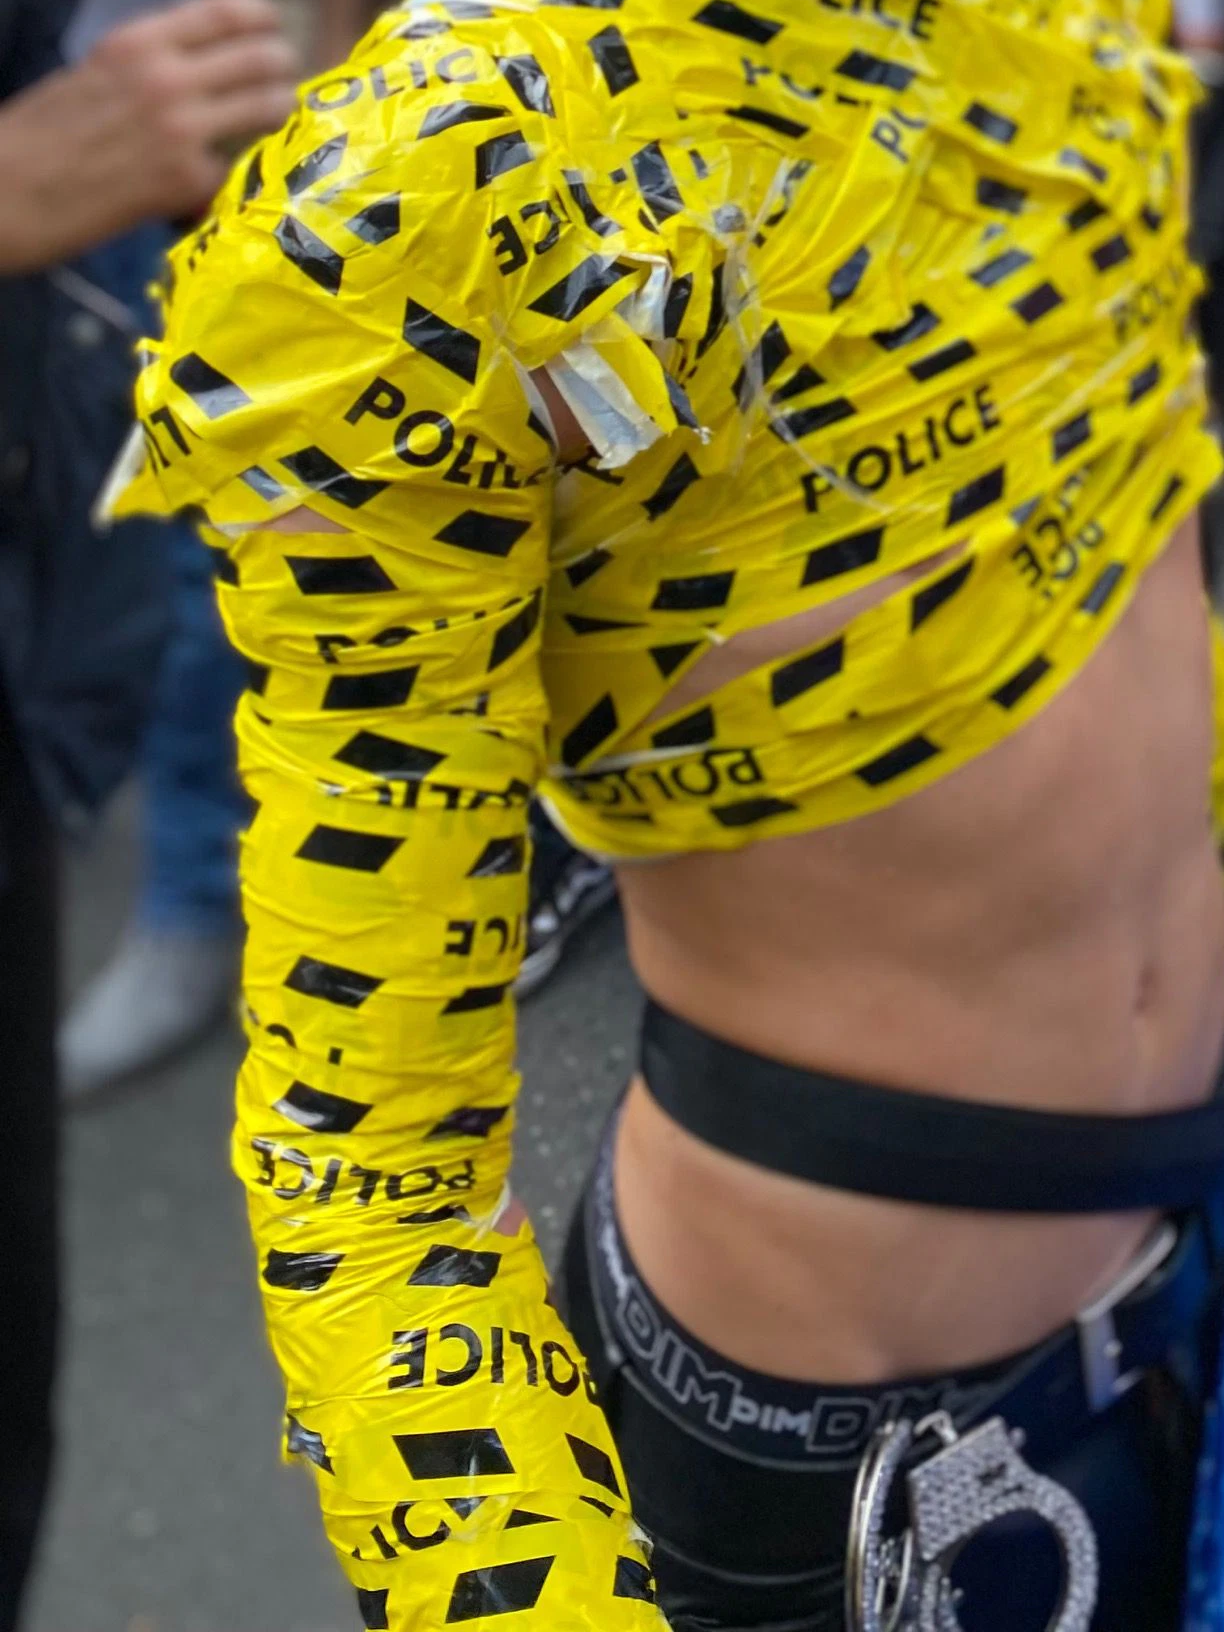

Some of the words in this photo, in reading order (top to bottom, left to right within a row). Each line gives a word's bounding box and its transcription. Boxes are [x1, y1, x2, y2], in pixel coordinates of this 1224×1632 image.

[306, 47, 478, 112] OLIC
[802, 383, 1002, 512] POLICE
[251, 1137, 477, 1206] POLICE
[615, 1275, 743, 1432] DIM
